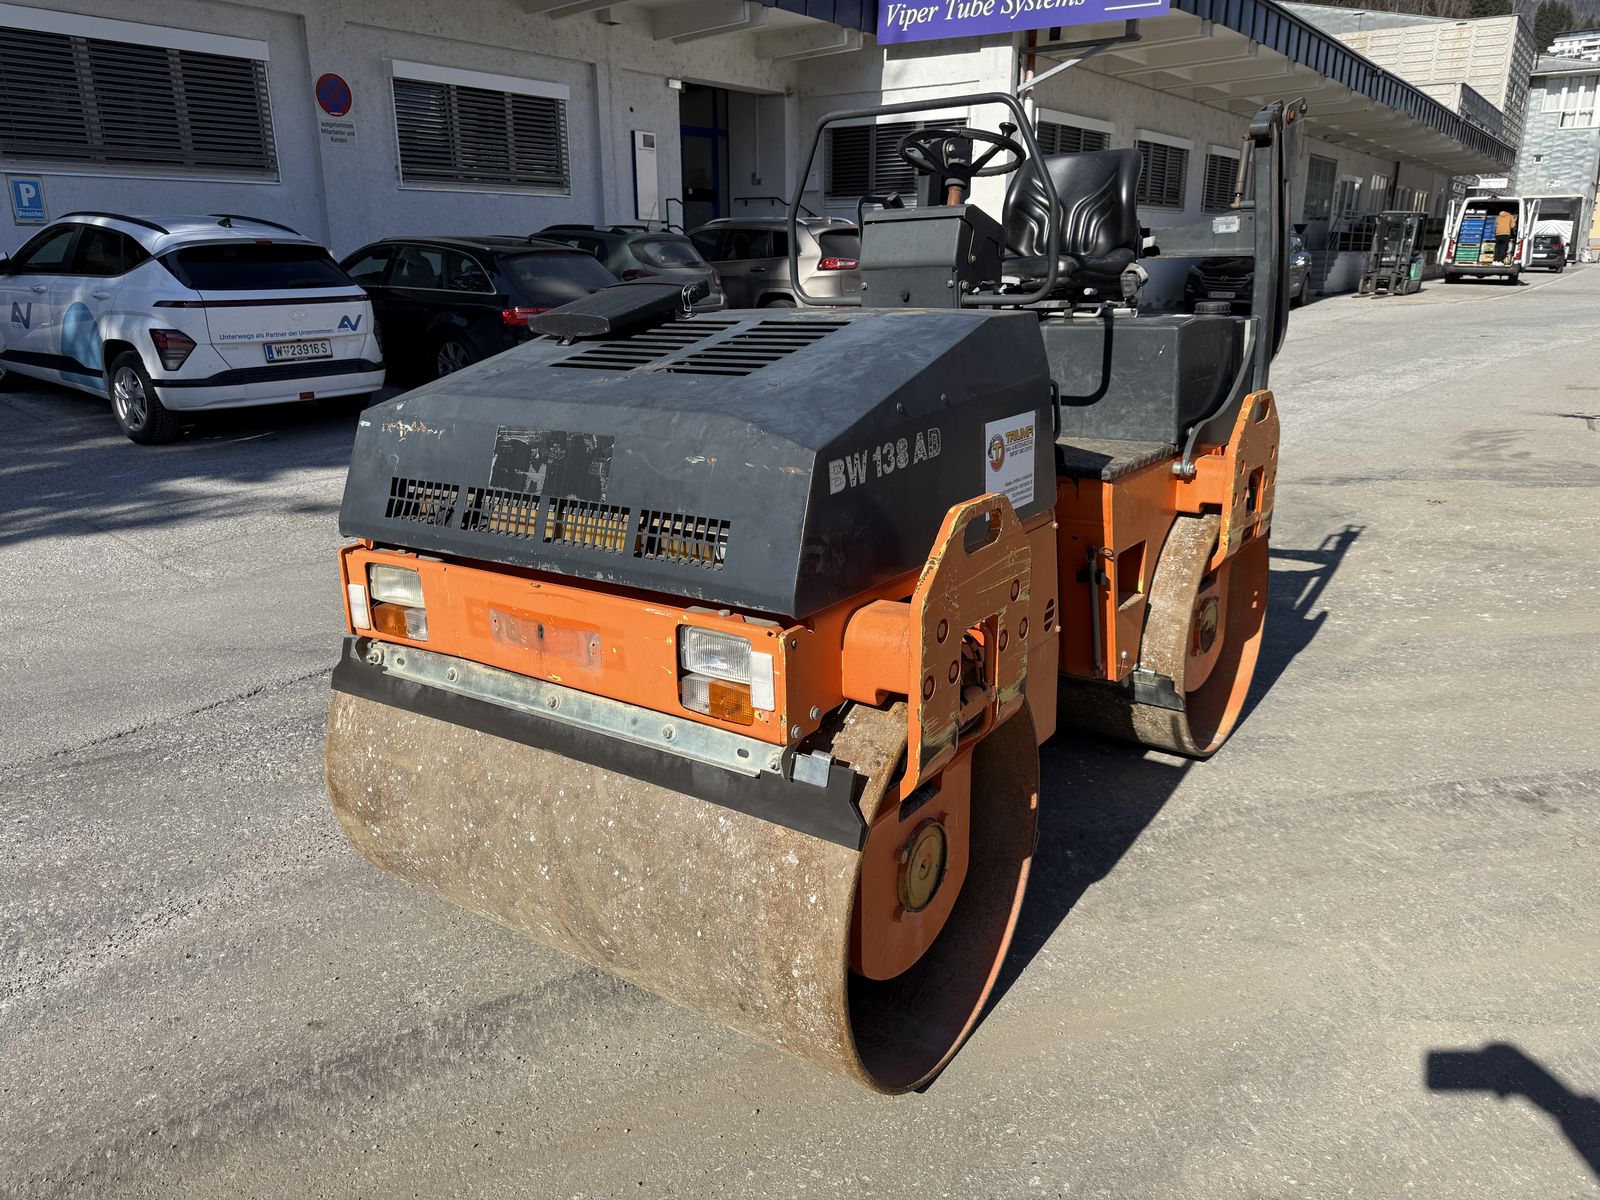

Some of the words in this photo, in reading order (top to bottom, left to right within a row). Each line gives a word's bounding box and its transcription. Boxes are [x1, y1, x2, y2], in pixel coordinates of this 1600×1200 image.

[886, 3, 939, 31] Viper
[944, 0, 995, 20] Tube
[18, 183, 36, 207] P
[219, 333, 255, 341] Unterwegs
[828, 449, 868, 495] BW
[872, 437, 910, 479] 138
[912, 427, 942, 465] AD
